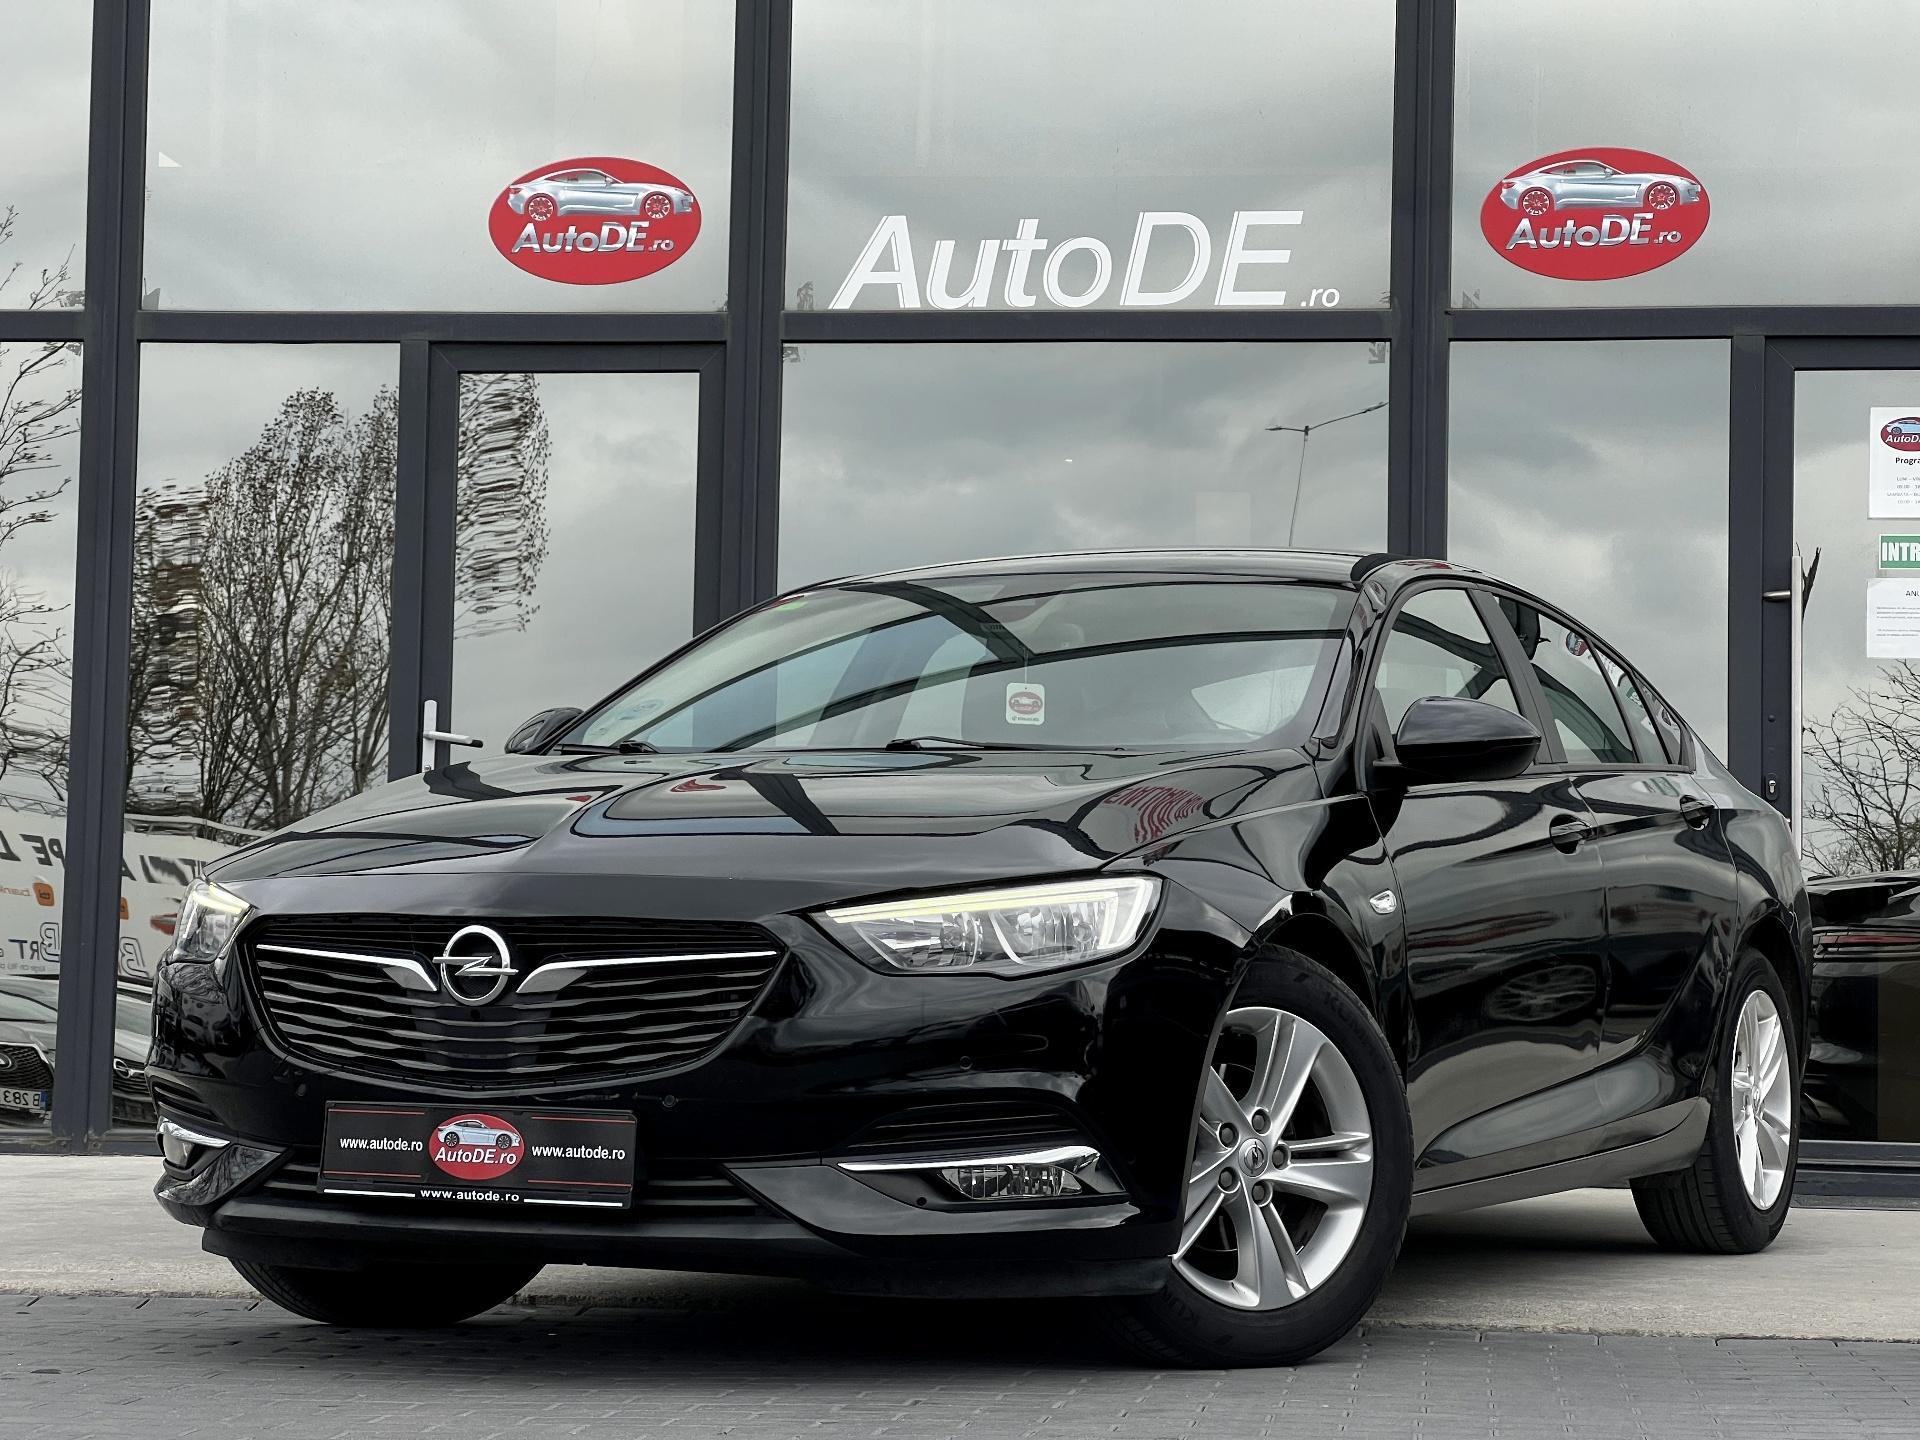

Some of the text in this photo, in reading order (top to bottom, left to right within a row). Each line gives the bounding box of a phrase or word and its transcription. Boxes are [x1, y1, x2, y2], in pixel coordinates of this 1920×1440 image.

[1885, 434, 1920, 443] AutoD
[340, 1136, 423, 1152] www.autode.ro
[531, 1144, 626, 1160] www.autode.ro
[434, 1148, 517, 1165] AutoDE.ro
[420, 1188, 520, 1202] www.autode.ro
